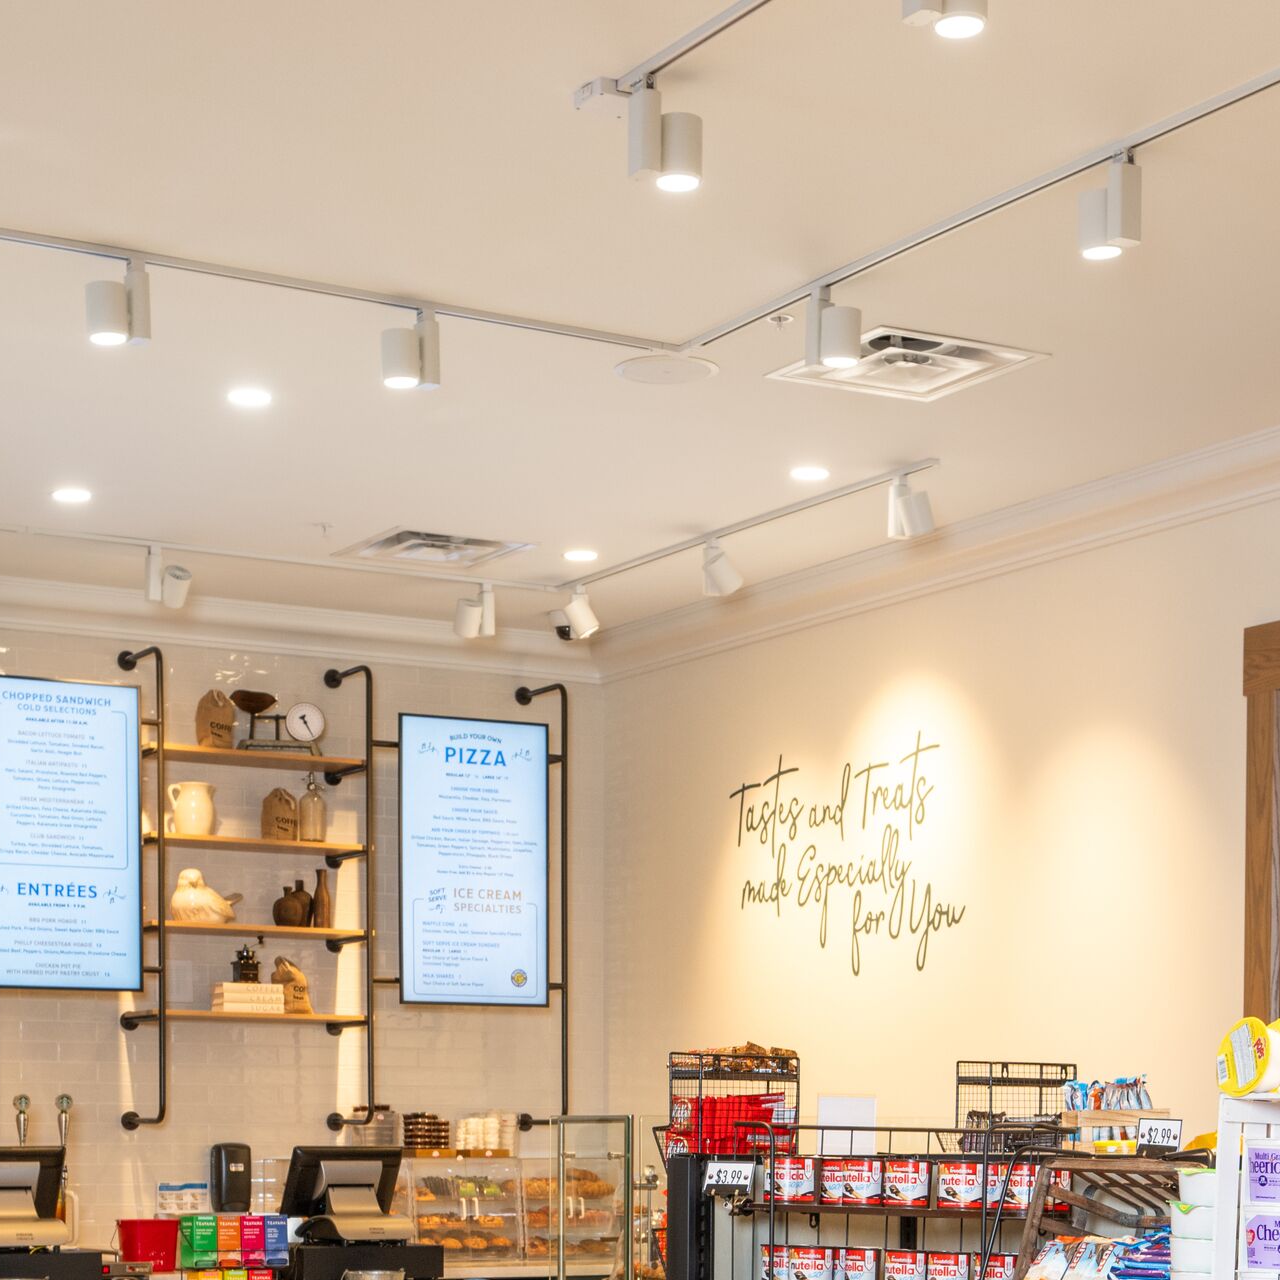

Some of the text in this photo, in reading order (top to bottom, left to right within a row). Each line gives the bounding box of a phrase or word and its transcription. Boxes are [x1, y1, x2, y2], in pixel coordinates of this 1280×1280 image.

[2, 691, 111, 706] CHOPPED SANDWICH
[43, 705, 97, 715] SELECTIONS
[487, 736, 502, 744] OWN
[445, 747, 506, 766] PIZZA
[730, 730, 940, 858] Tastes and Treats
[17, 882, 97, 898] ENTRÉES
[741, 824, 912, 949] made Especially
[454, 888, 522, 901] ICE CREAM
[454, 903, 522, 914] SPECIALTIES
[852, 880, 966, 976] for You
[1147, 1126, 1172, 1145] $2.99
[1255, 1153, 1269, 1161] Multi
[716, 1169, 743, 1184] $3.99
[941, 1175, 974, 1186] nutella
[790, 1260, 823, 1271] nutella
